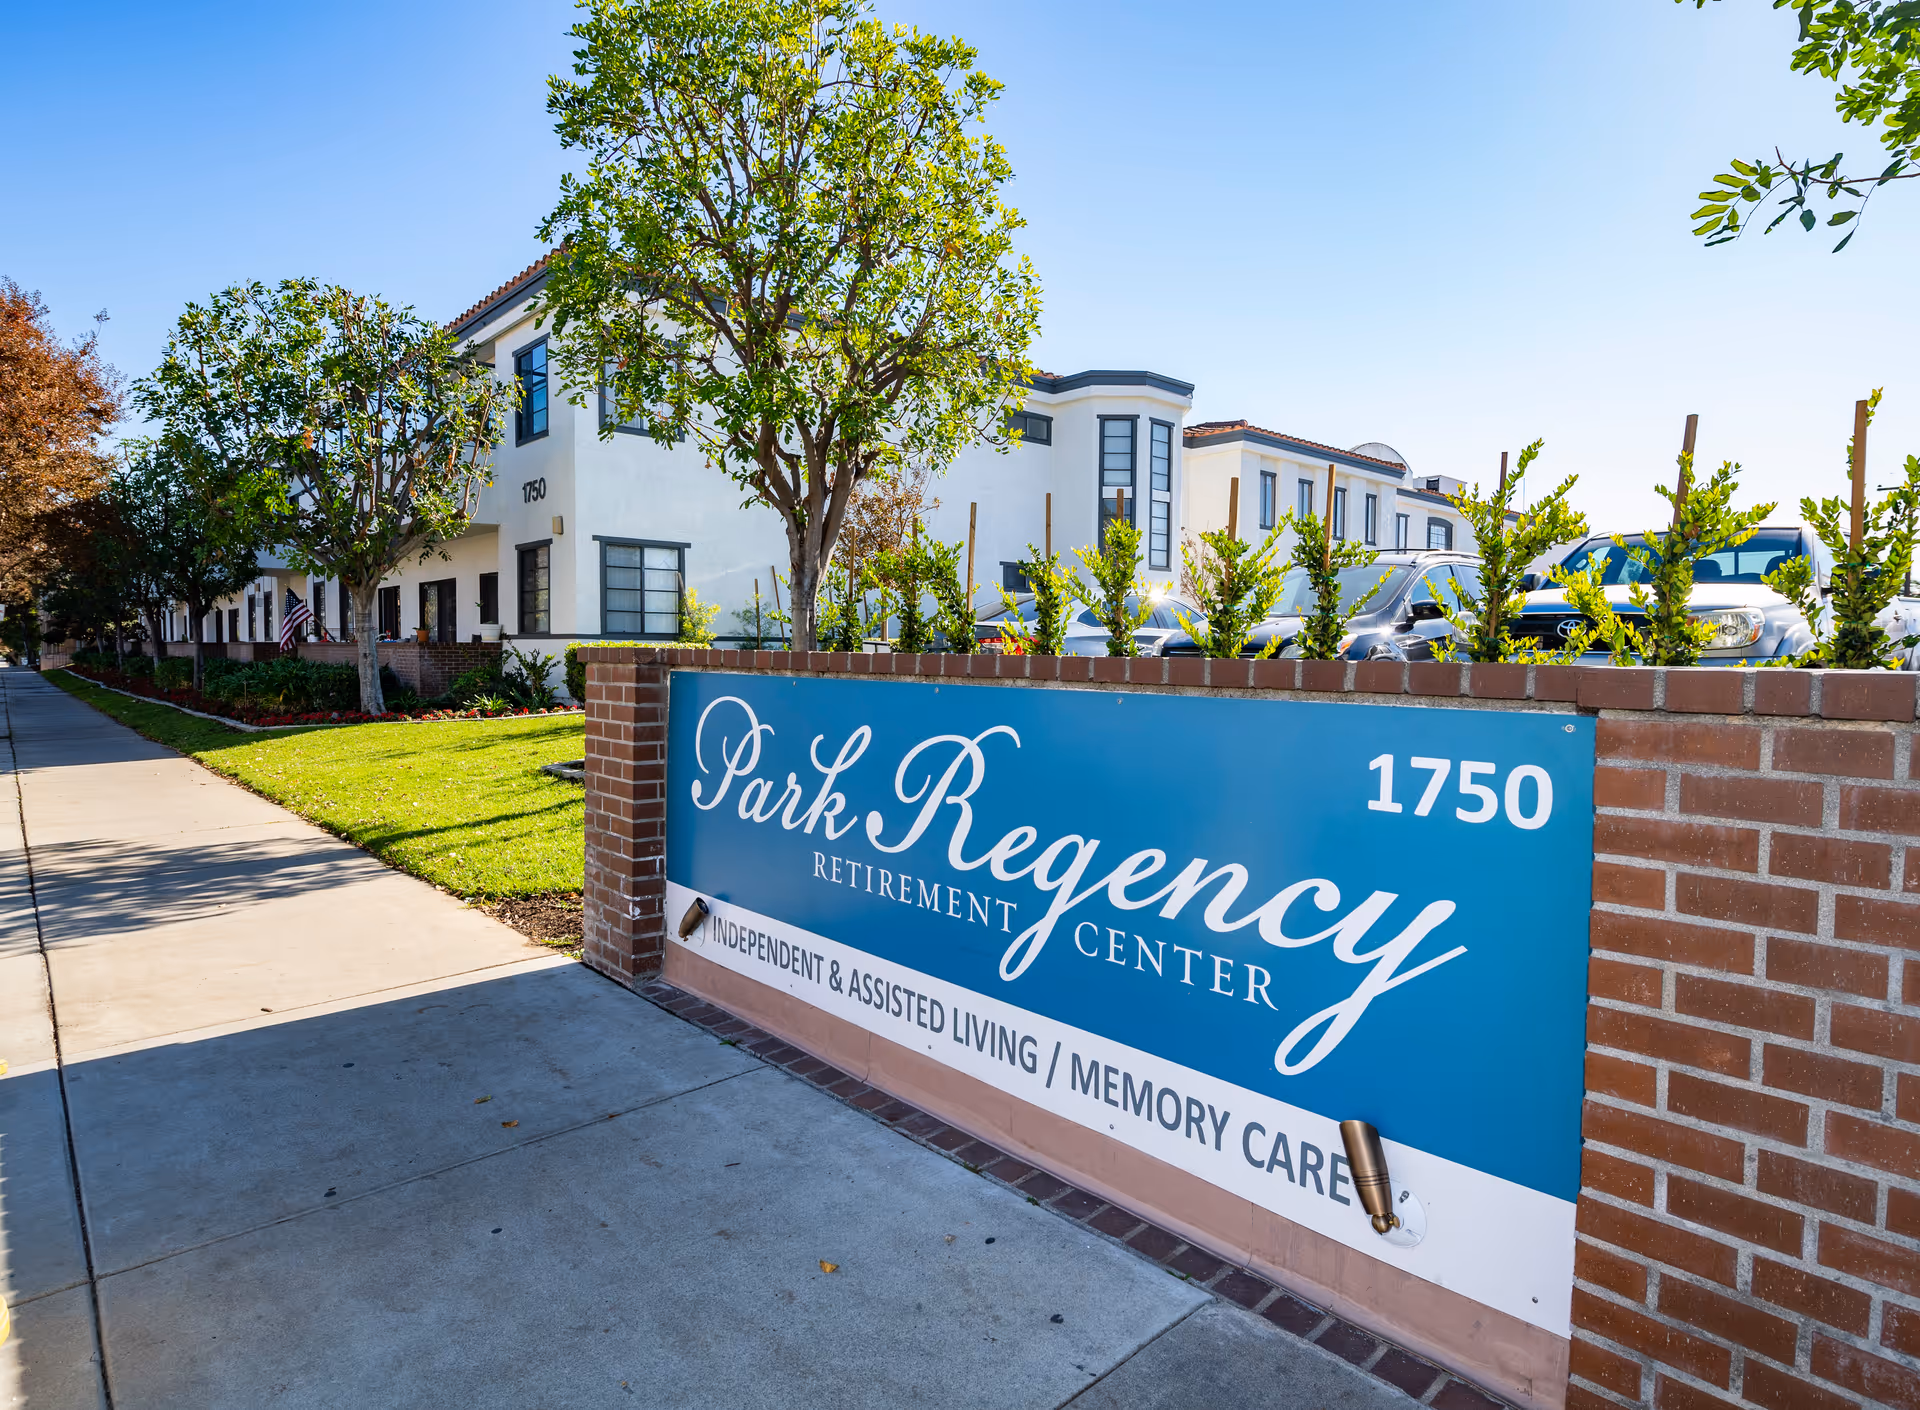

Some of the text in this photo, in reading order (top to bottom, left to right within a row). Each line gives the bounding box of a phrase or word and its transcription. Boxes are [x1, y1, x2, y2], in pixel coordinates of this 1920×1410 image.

[522, 477, 547, 504] 1750
[1367, 753, 1553, 830] 1750
[691, 695, 1468, 1076] Park Regency
[813, 851, 1279, 1011] RETIREMENT CENTER
[712, 915, 1351, 1207] INDEPENDENT & ASSISTED LIVING / MEMORY CARE
